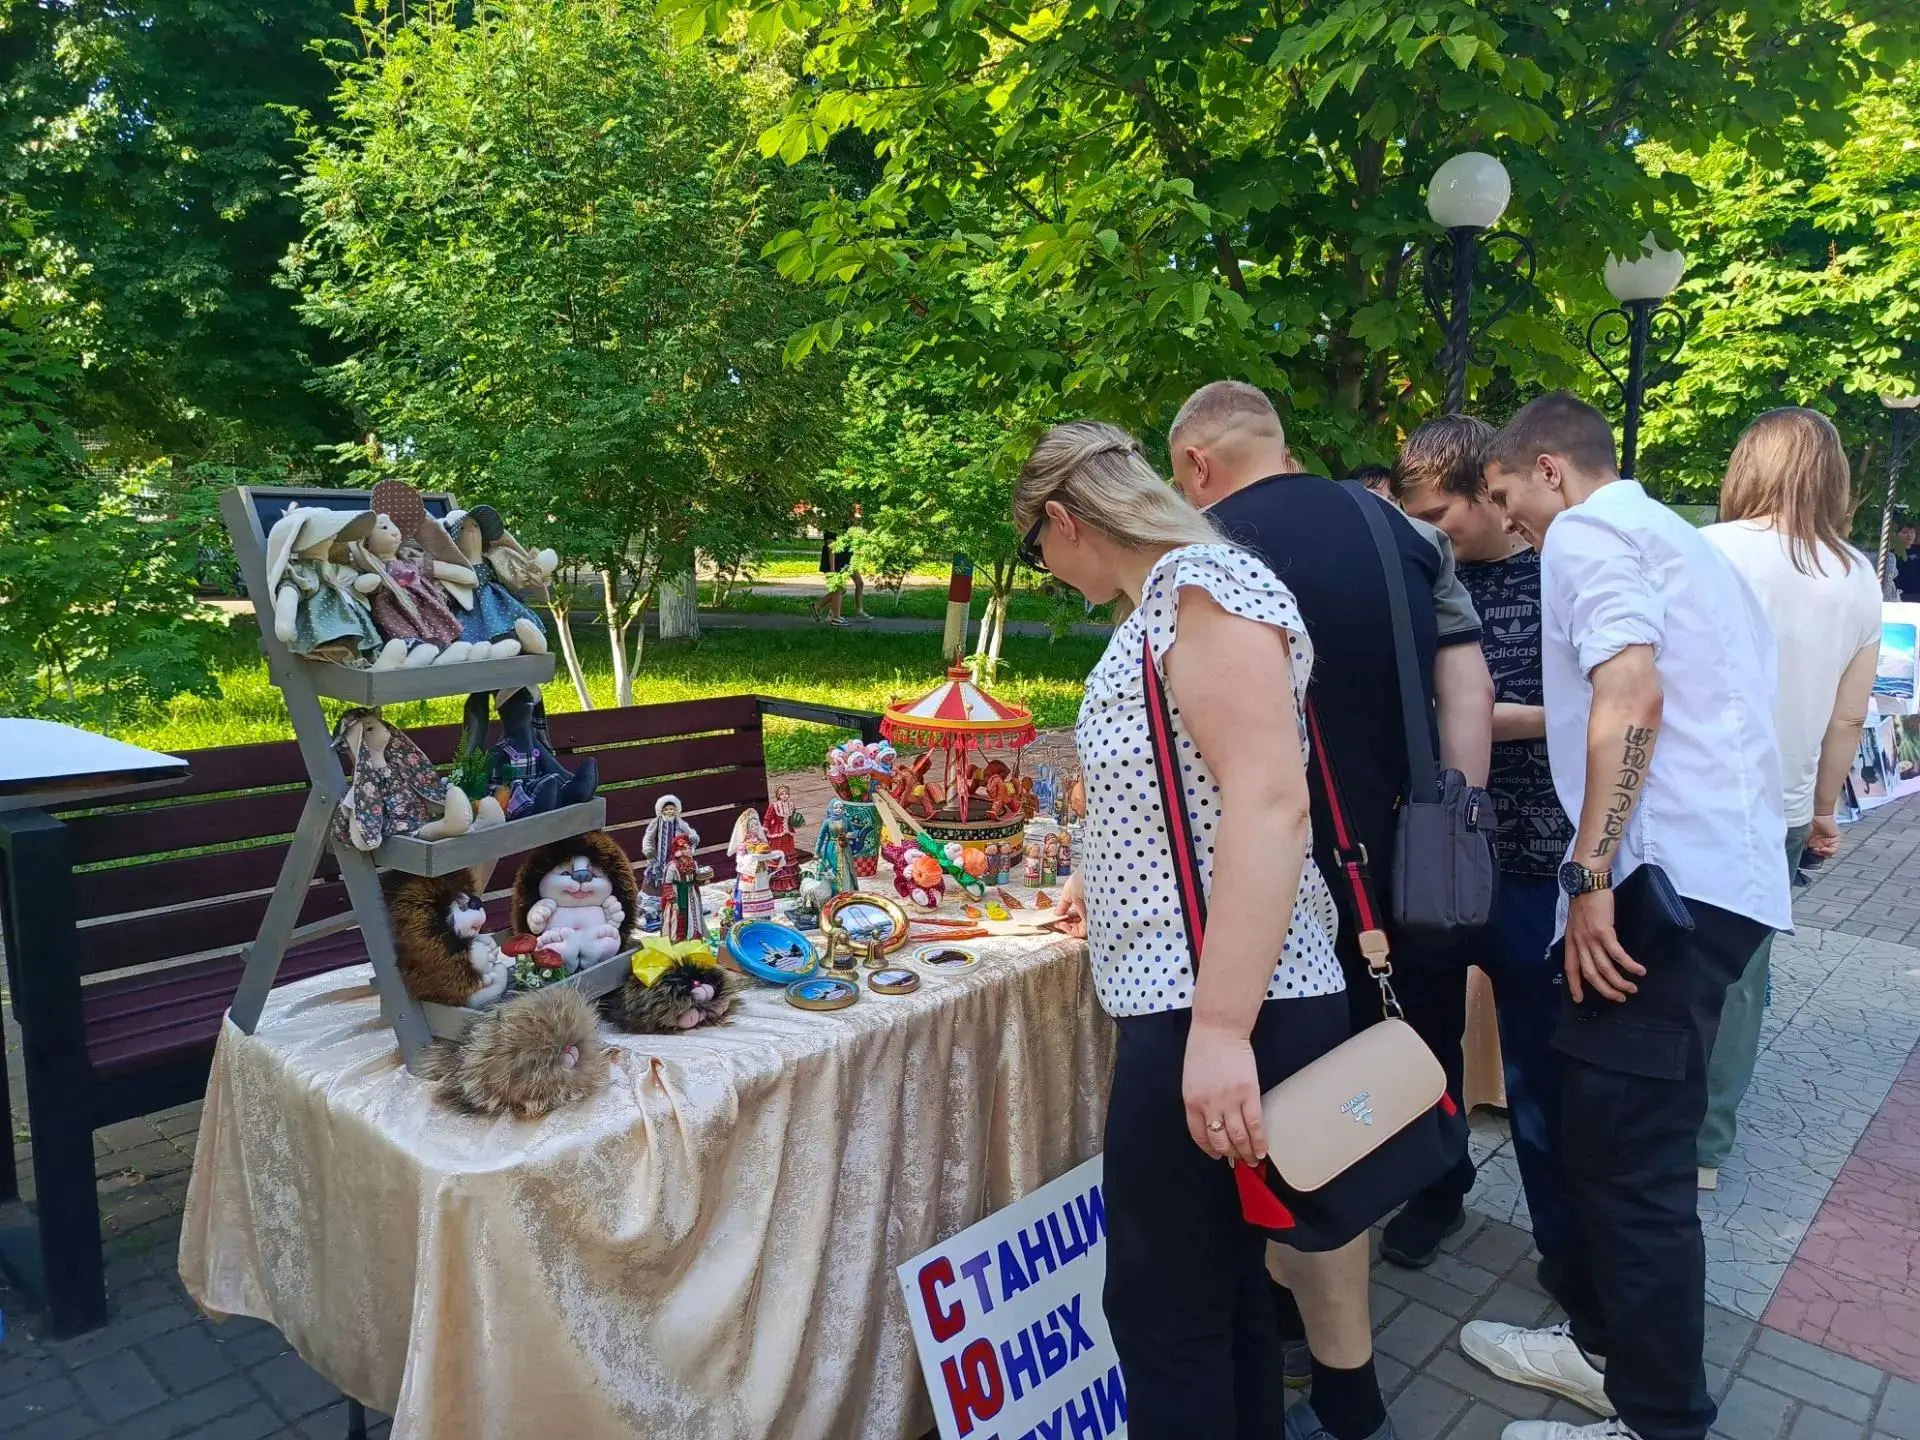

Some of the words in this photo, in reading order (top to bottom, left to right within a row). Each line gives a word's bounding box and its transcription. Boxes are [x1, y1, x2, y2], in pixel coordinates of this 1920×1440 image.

[1484, 604, 1533, 621] PUMA
[1484, 646, 1538, 661] adidas
[1506, 676, 1542, 687] adida
[940, 1292, 1096, 1440] ЮНЫХ
